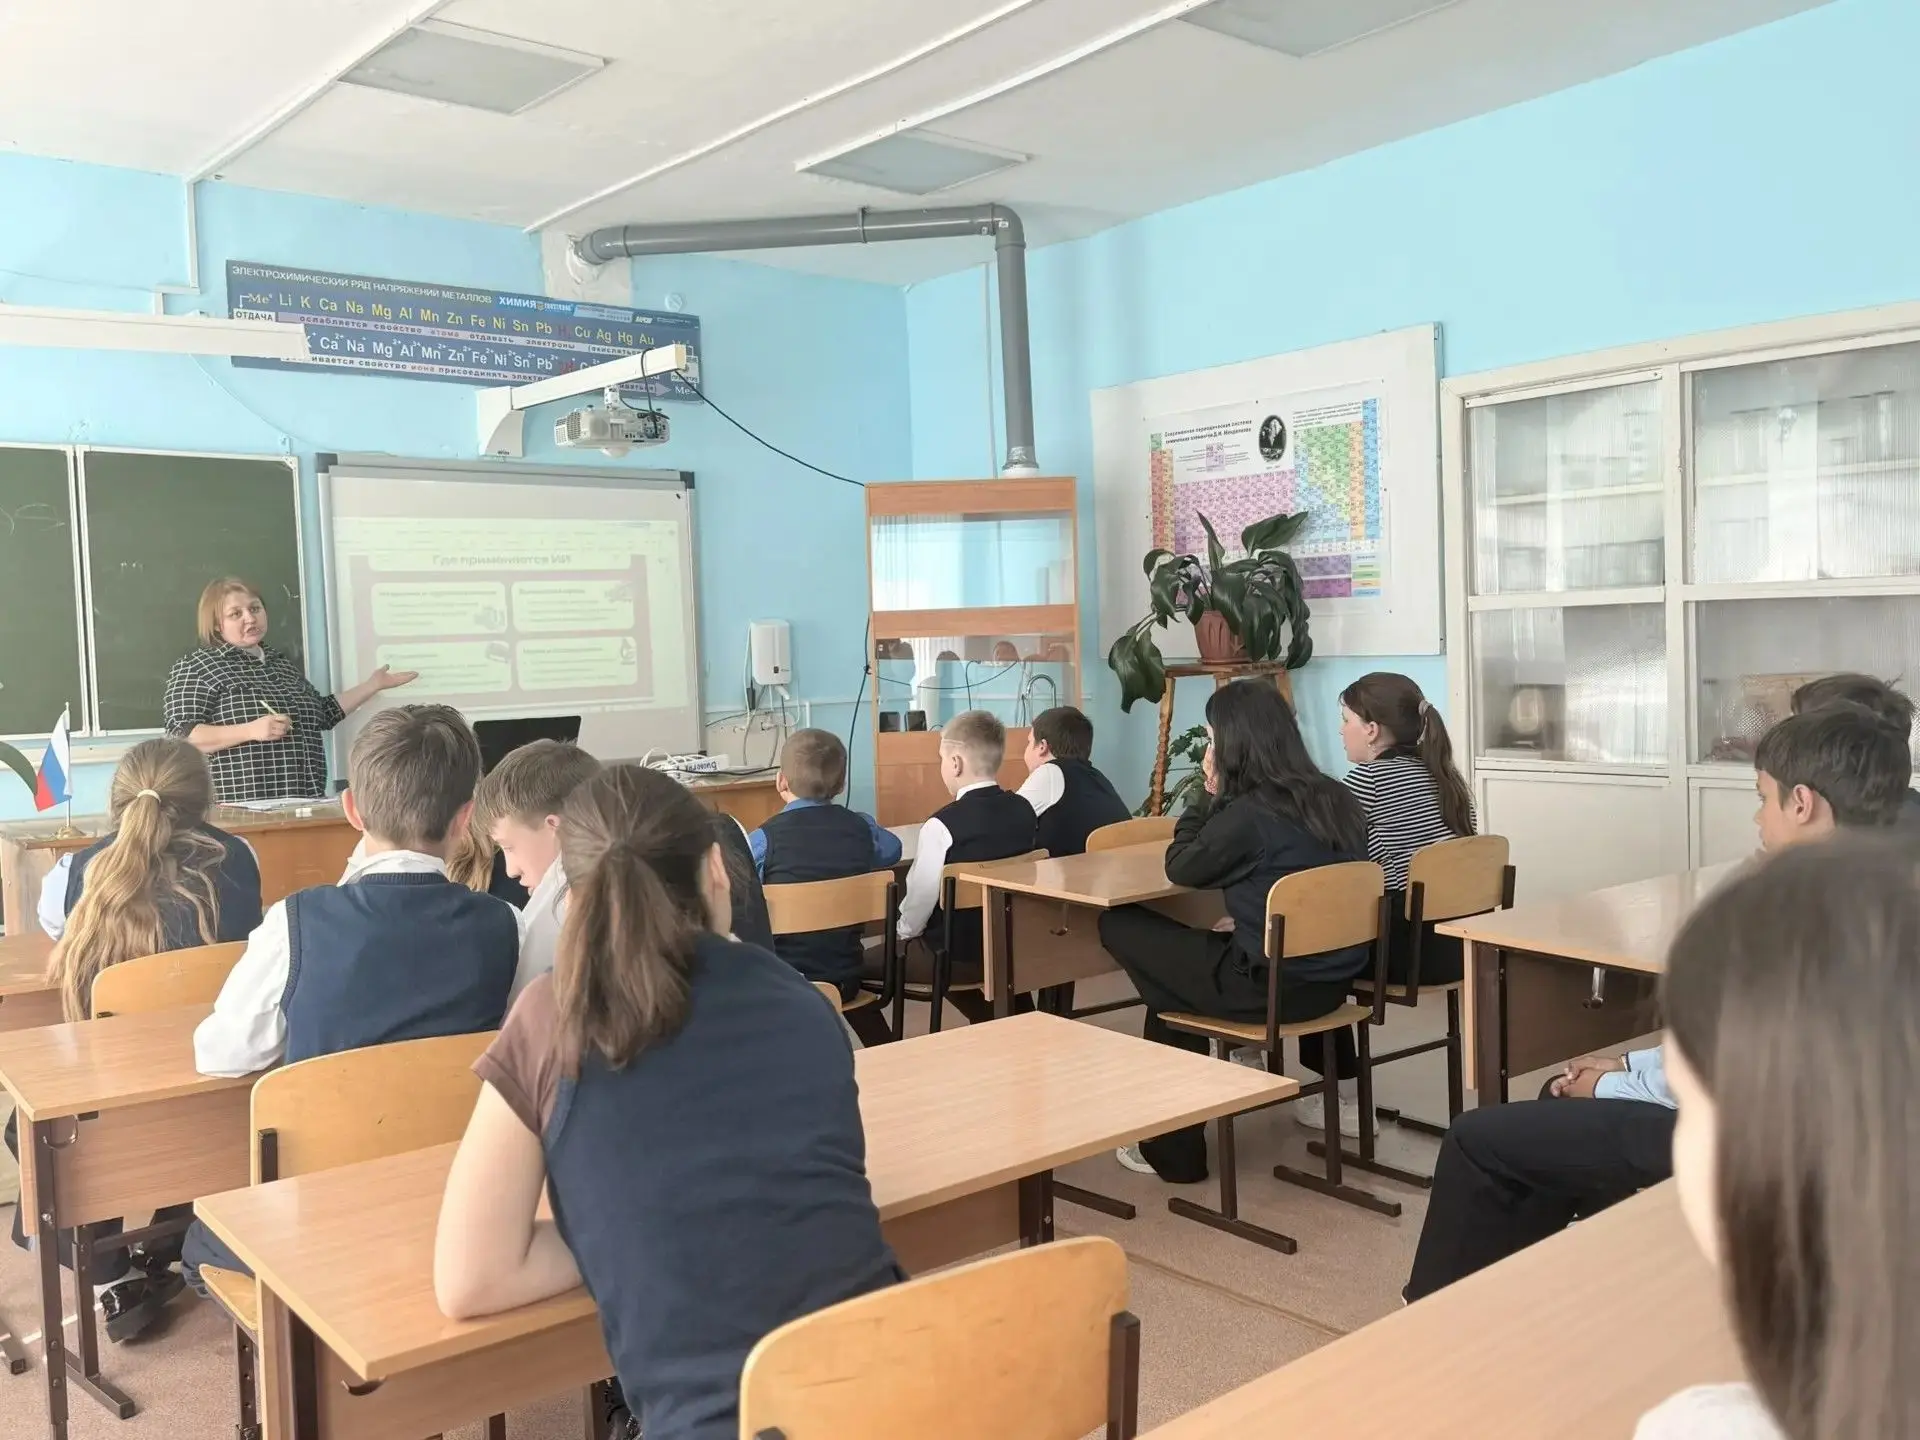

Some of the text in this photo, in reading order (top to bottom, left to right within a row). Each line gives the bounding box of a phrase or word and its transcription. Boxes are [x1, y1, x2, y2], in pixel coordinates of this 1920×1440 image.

[232, 266, 492, 304] ЭЛЕКТРОХИМИЧЕСКИЙ РЯД НАПРЯЖЕНИЙ МЕТАЛЛОВ
[235, 311, 273, 321] ОТДАЧА
[499, 296, 537, 309] ХИМИЯ
[279, 293, 292, 306] Li
[300, 295, 311, 309] K
[319, 298, 337, 311] Ca
[345, 301, 364, 314] Na
[371, 304, 392, 320] Mg
[399, 307, 412, 319] Al
[420, 308, 440, 322] Mn
[446, 312, 463, 324] Zn
[470, 314, 485, 327] Fe
[493, 316, 505, 329] Ni
[512, 319, 529, 332] Sn
[535, 321, 552, 334] Pb
[575, 325, 591, 338] Cu
[596, 329, 612, 343] Ag
[618, 331, 633, 345] Hg
[639, 333, 655, 345] Au
[299, 315, 368, 328] ослабляется
[374, 323, 423, 333] свойство
[469, 334, 514, 343] отдавать
[526, 339, 575, 349] электроны
[358, 359, 407, 370] свойство
[411, 365, 435, 373] иона
[438, 367, 508, 379] присоединять
